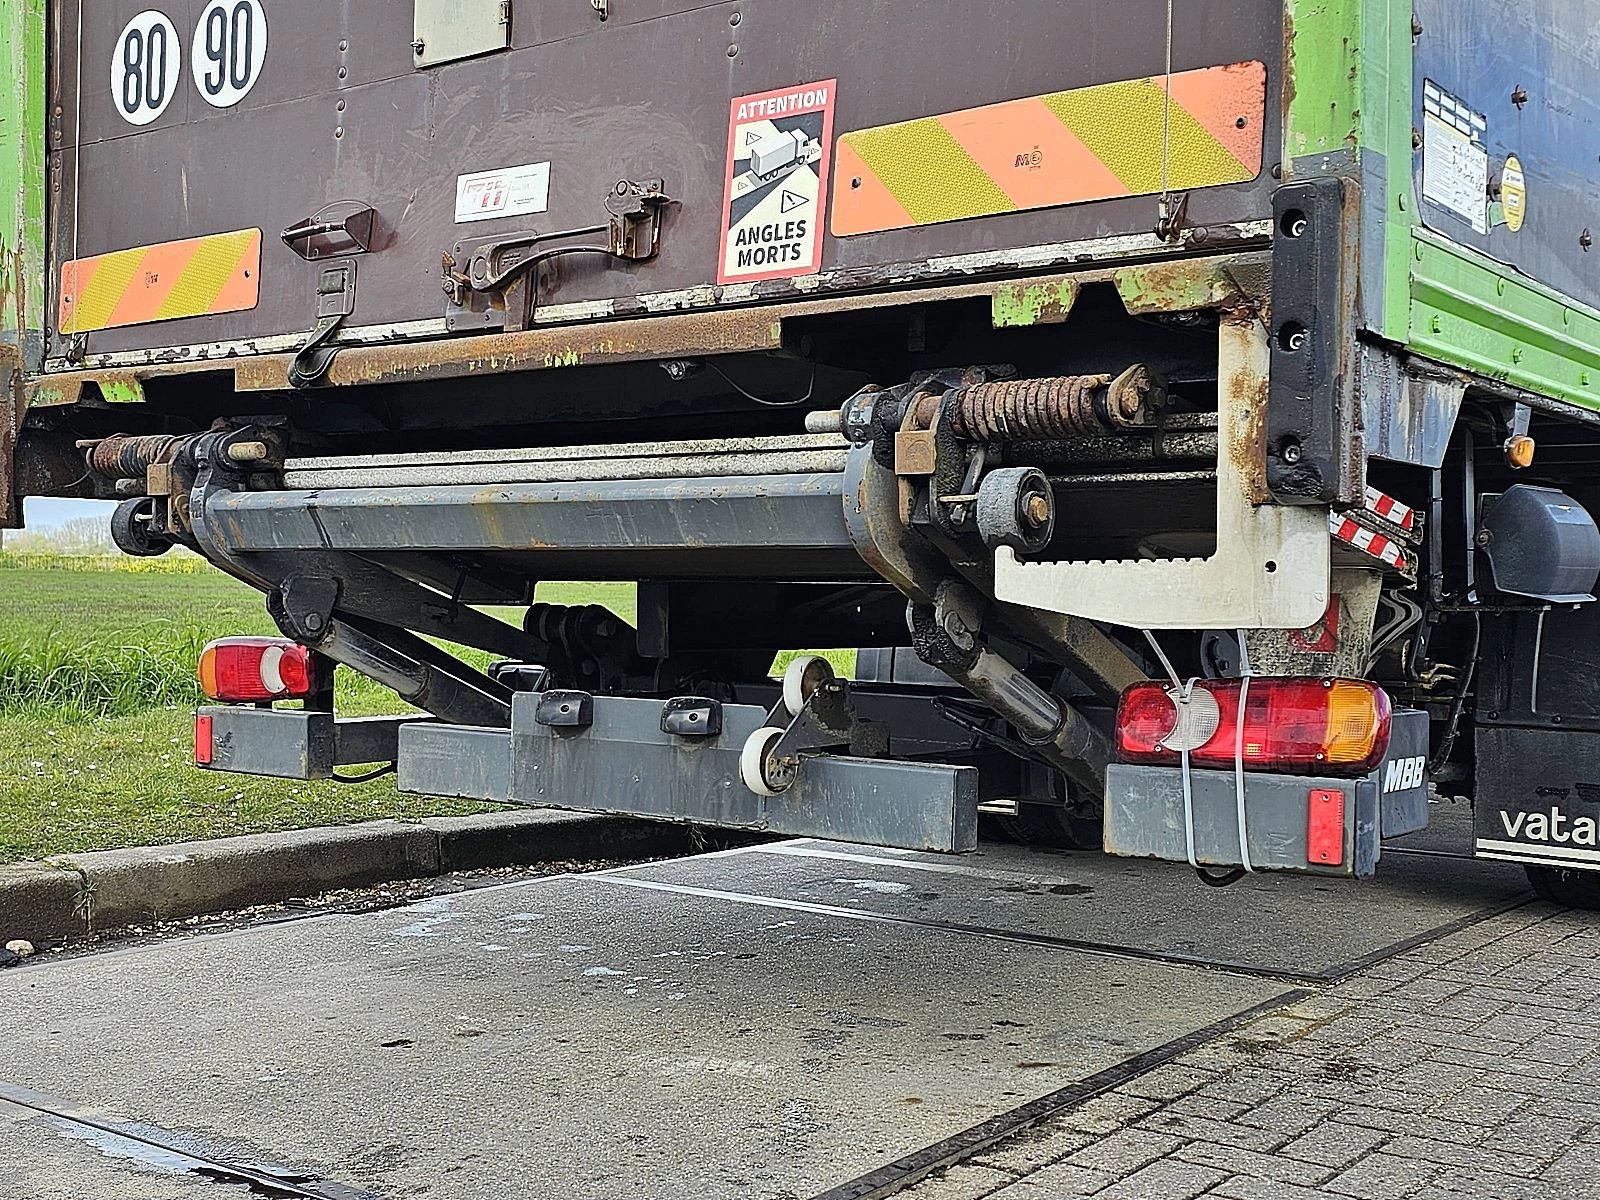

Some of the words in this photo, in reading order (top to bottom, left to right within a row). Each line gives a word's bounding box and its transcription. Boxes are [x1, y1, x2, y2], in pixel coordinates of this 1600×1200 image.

[204, 0, 253, 95] 90
[123, 23, 166, 113] 80
[736, 87, 828, 120] ATTENTION
[735, 219, 807, 247] ANGLES
[737, 242, 802, 268] MORTS
[1383, 755, 1426, 794] MBB
[1499, 806, 1600, 846] vata
